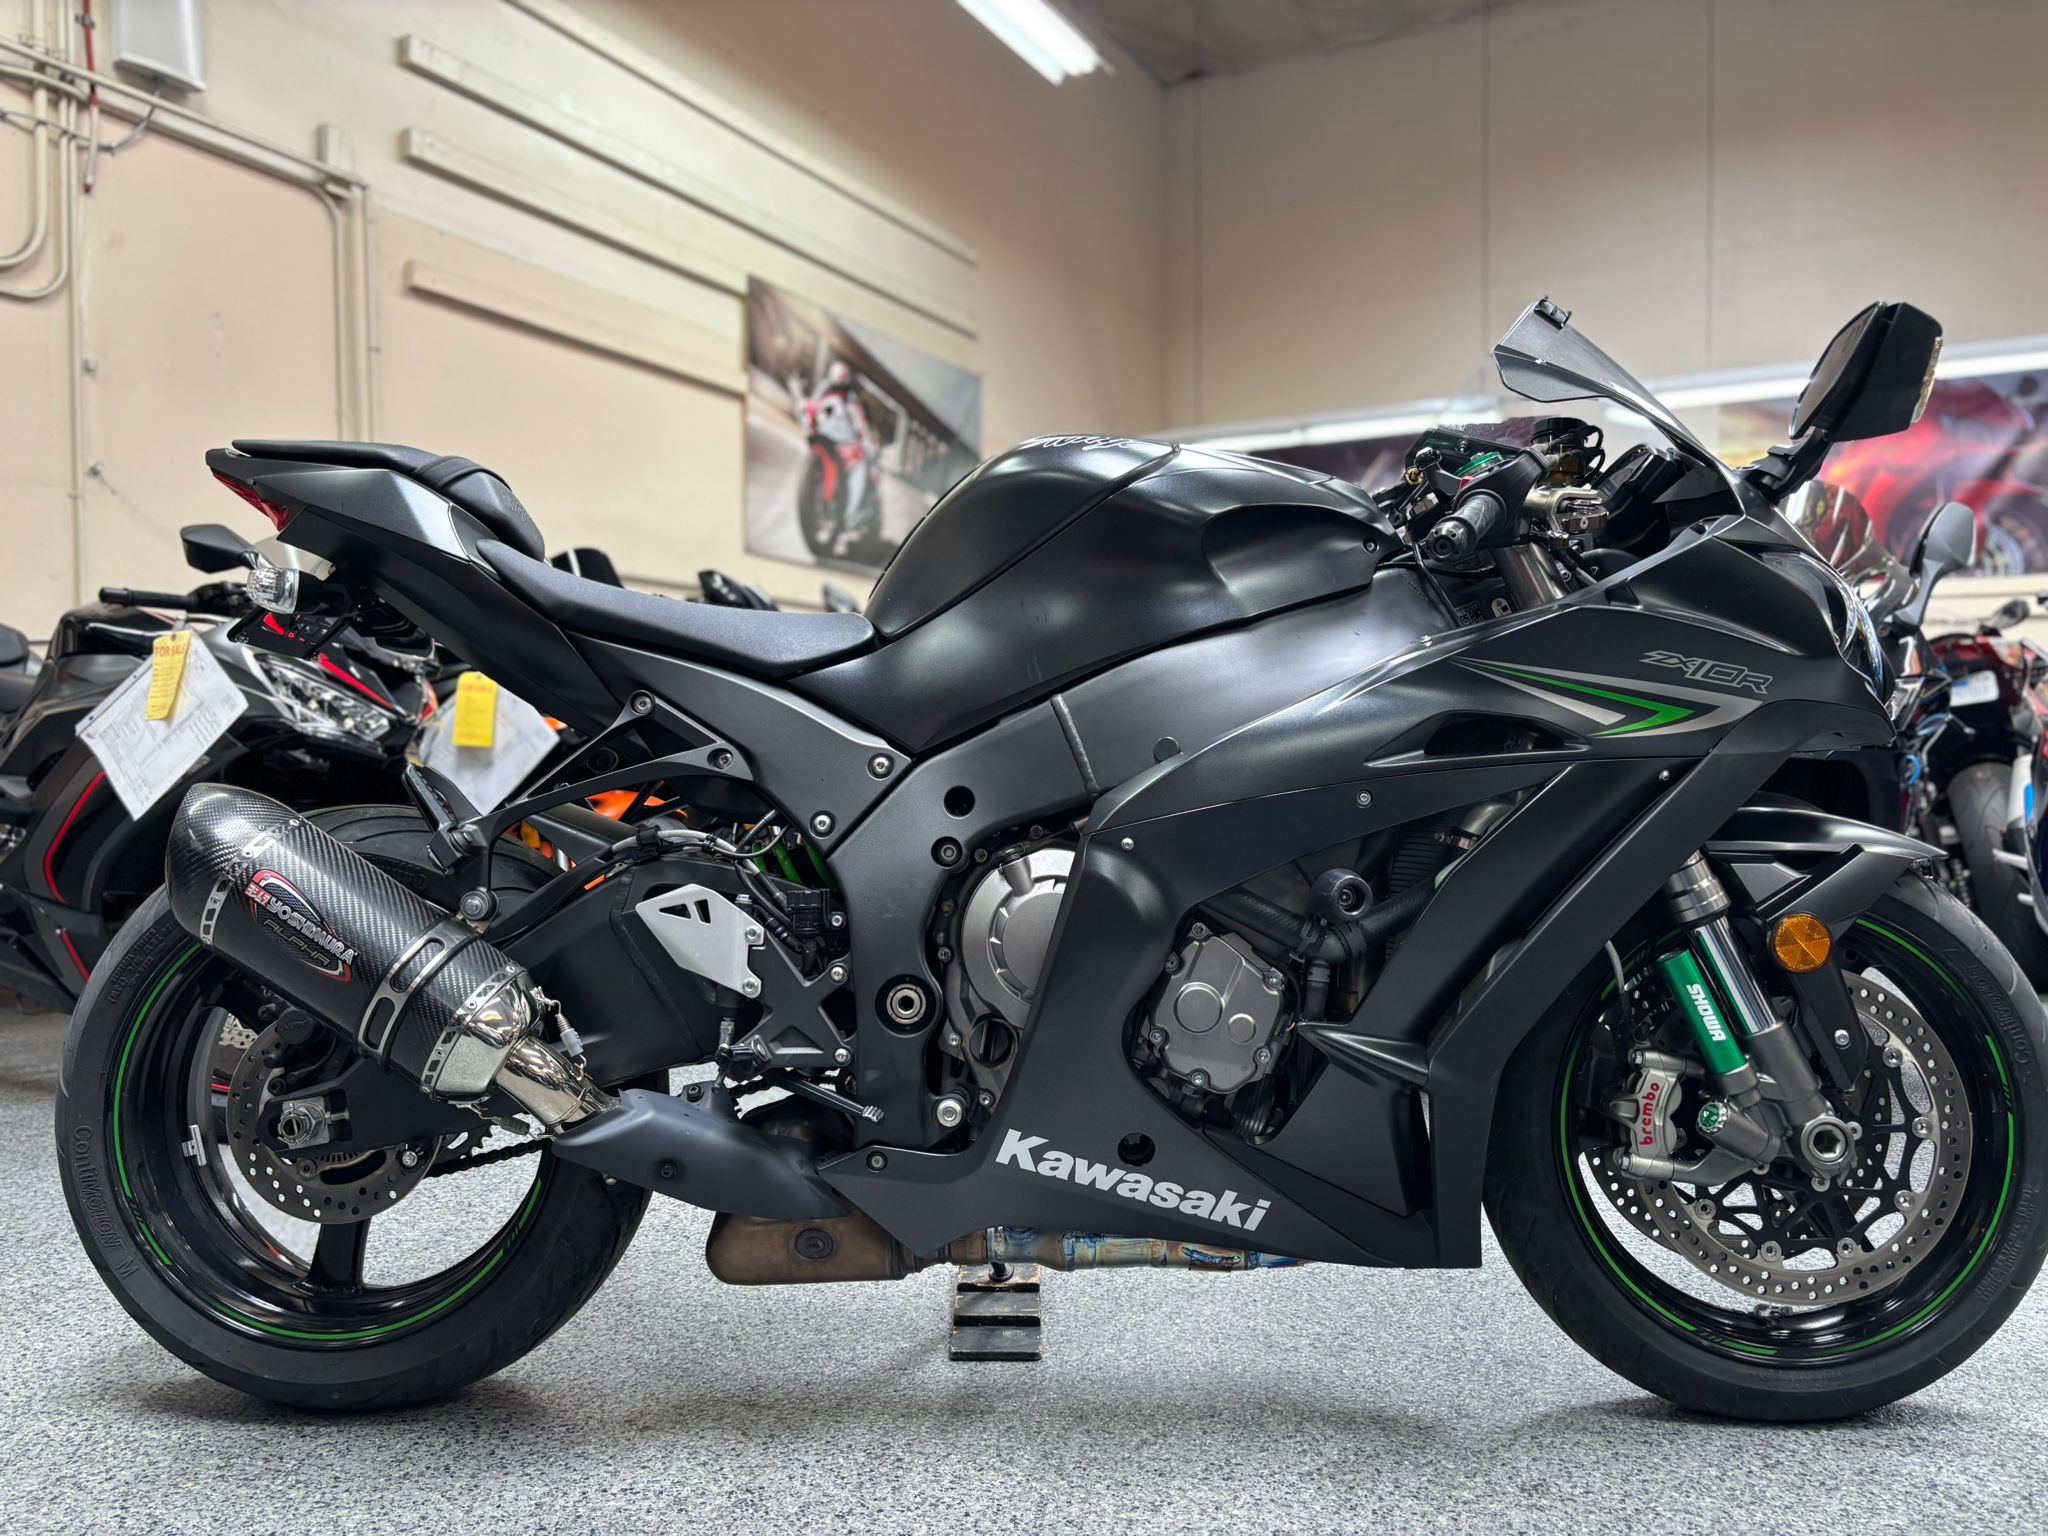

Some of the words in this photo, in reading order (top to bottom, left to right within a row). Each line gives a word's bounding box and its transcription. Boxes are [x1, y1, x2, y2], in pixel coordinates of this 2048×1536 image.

[155, 646, 171, 657] FOR
[263, 919, 331, 966] ALPHA
[266, 896, 356, 966] YOSHIMURA
[1686, 983, 1727, 1041] SHOWA
[1639, 1082, 1660, 1146] brembo
[995, 1128, 1271, 1232] Kawasaki
